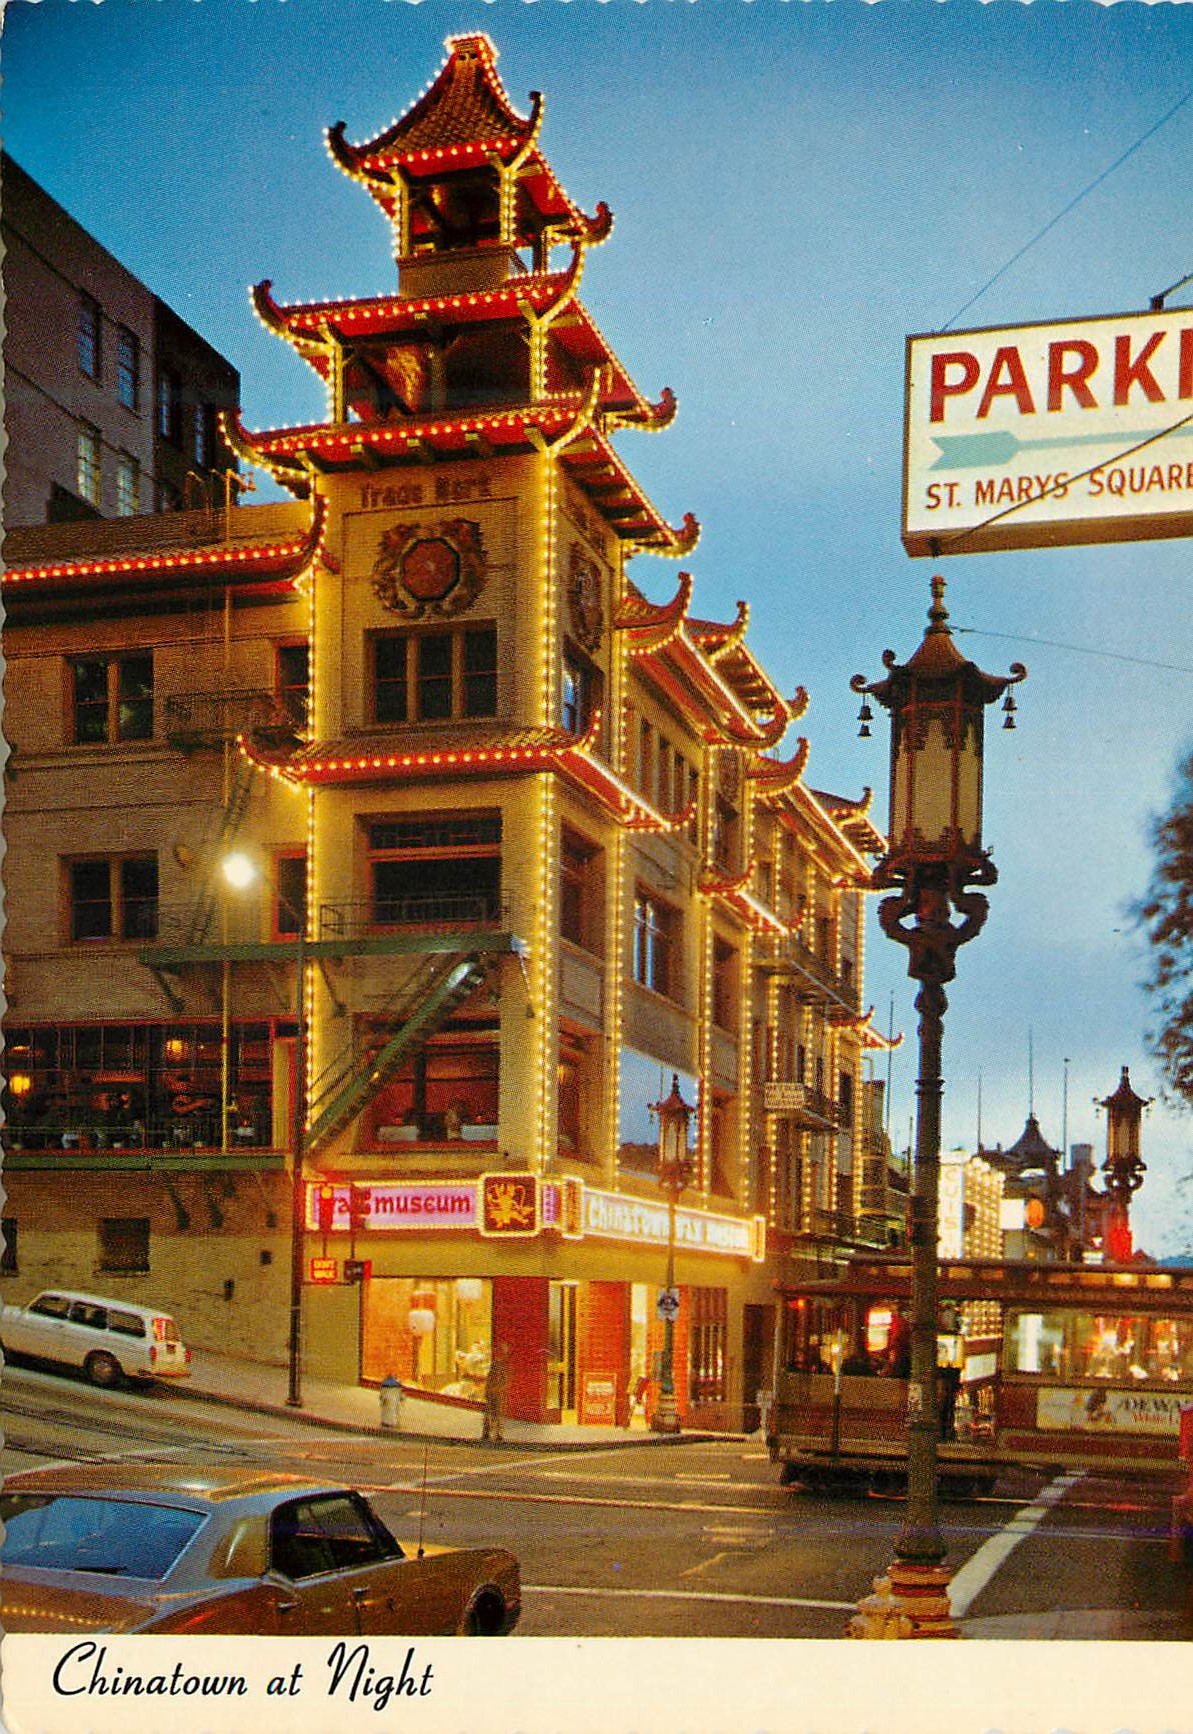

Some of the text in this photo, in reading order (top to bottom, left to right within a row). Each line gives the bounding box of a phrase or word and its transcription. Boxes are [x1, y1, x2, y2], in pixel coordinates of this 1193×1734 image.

[930, 328, 1193, 423] PARKI
[926, 482, 962, 510] ST.
[975, 471, 1070, 506] MARYS
[375, 1194, 472, 1215] museum
